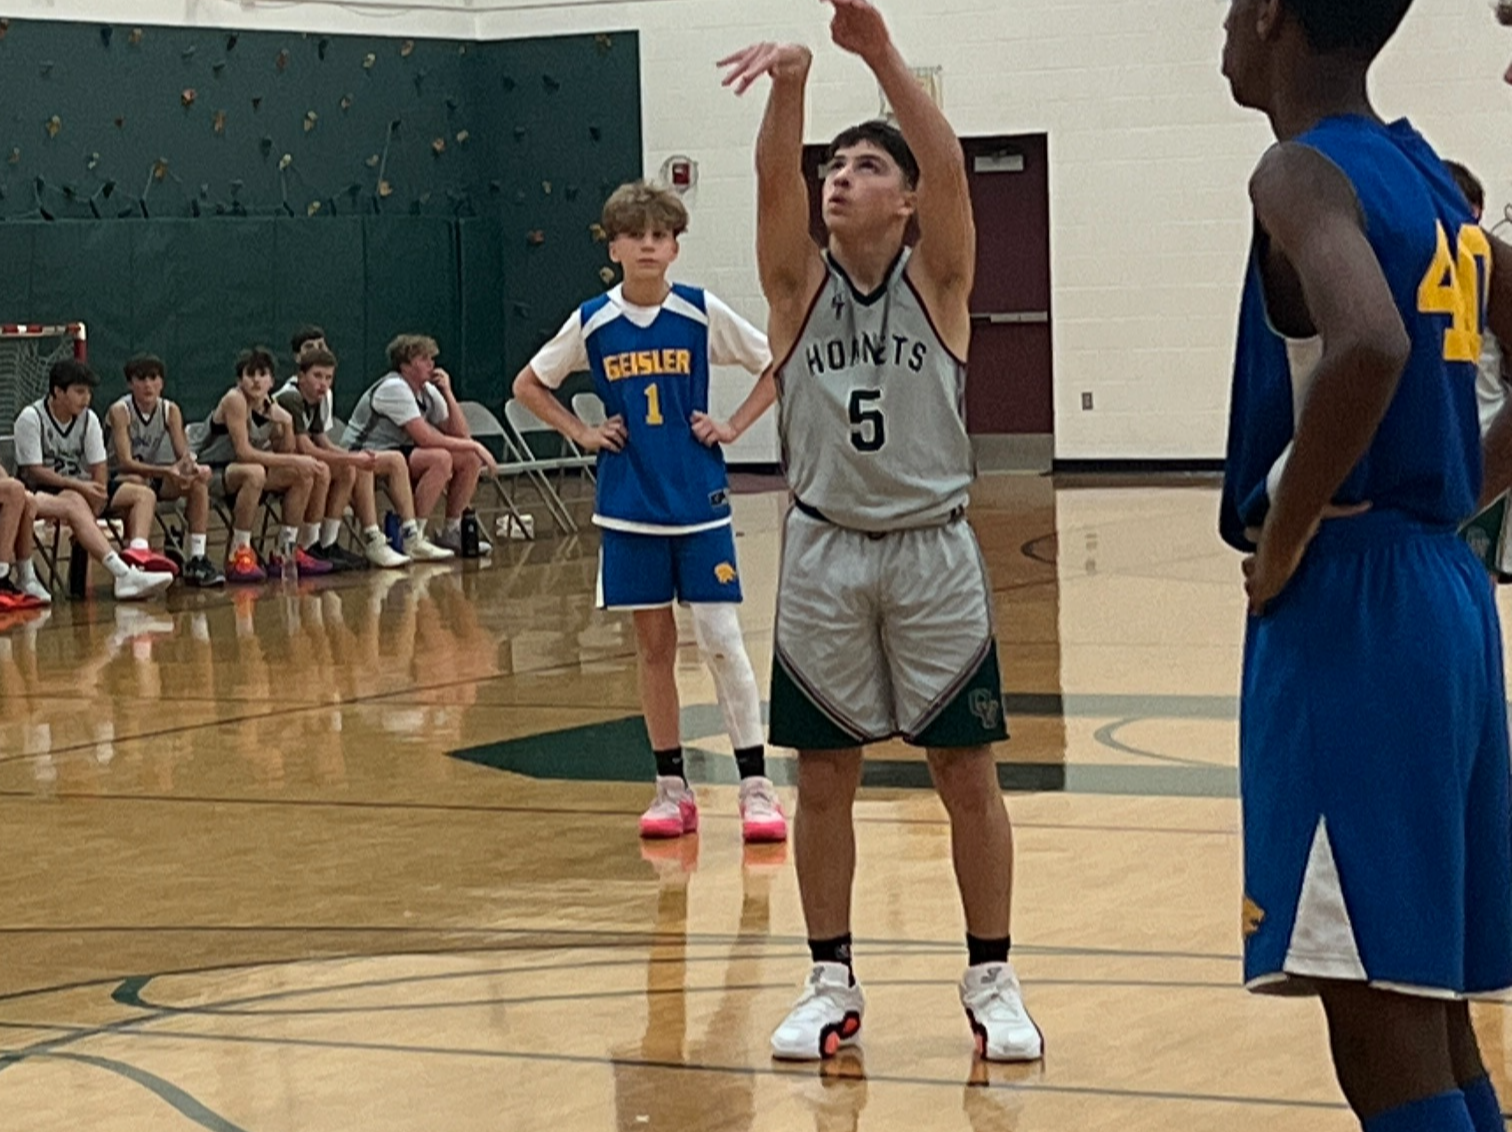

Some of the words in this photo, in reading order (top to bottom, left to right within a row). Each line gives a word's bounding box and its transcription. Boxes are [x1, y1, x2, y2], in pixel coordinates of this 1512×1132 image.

[603, 348, 691, 381] GEISLER
[643, 383, 663, 425] 1
[849, 389, 885, 451] 5
